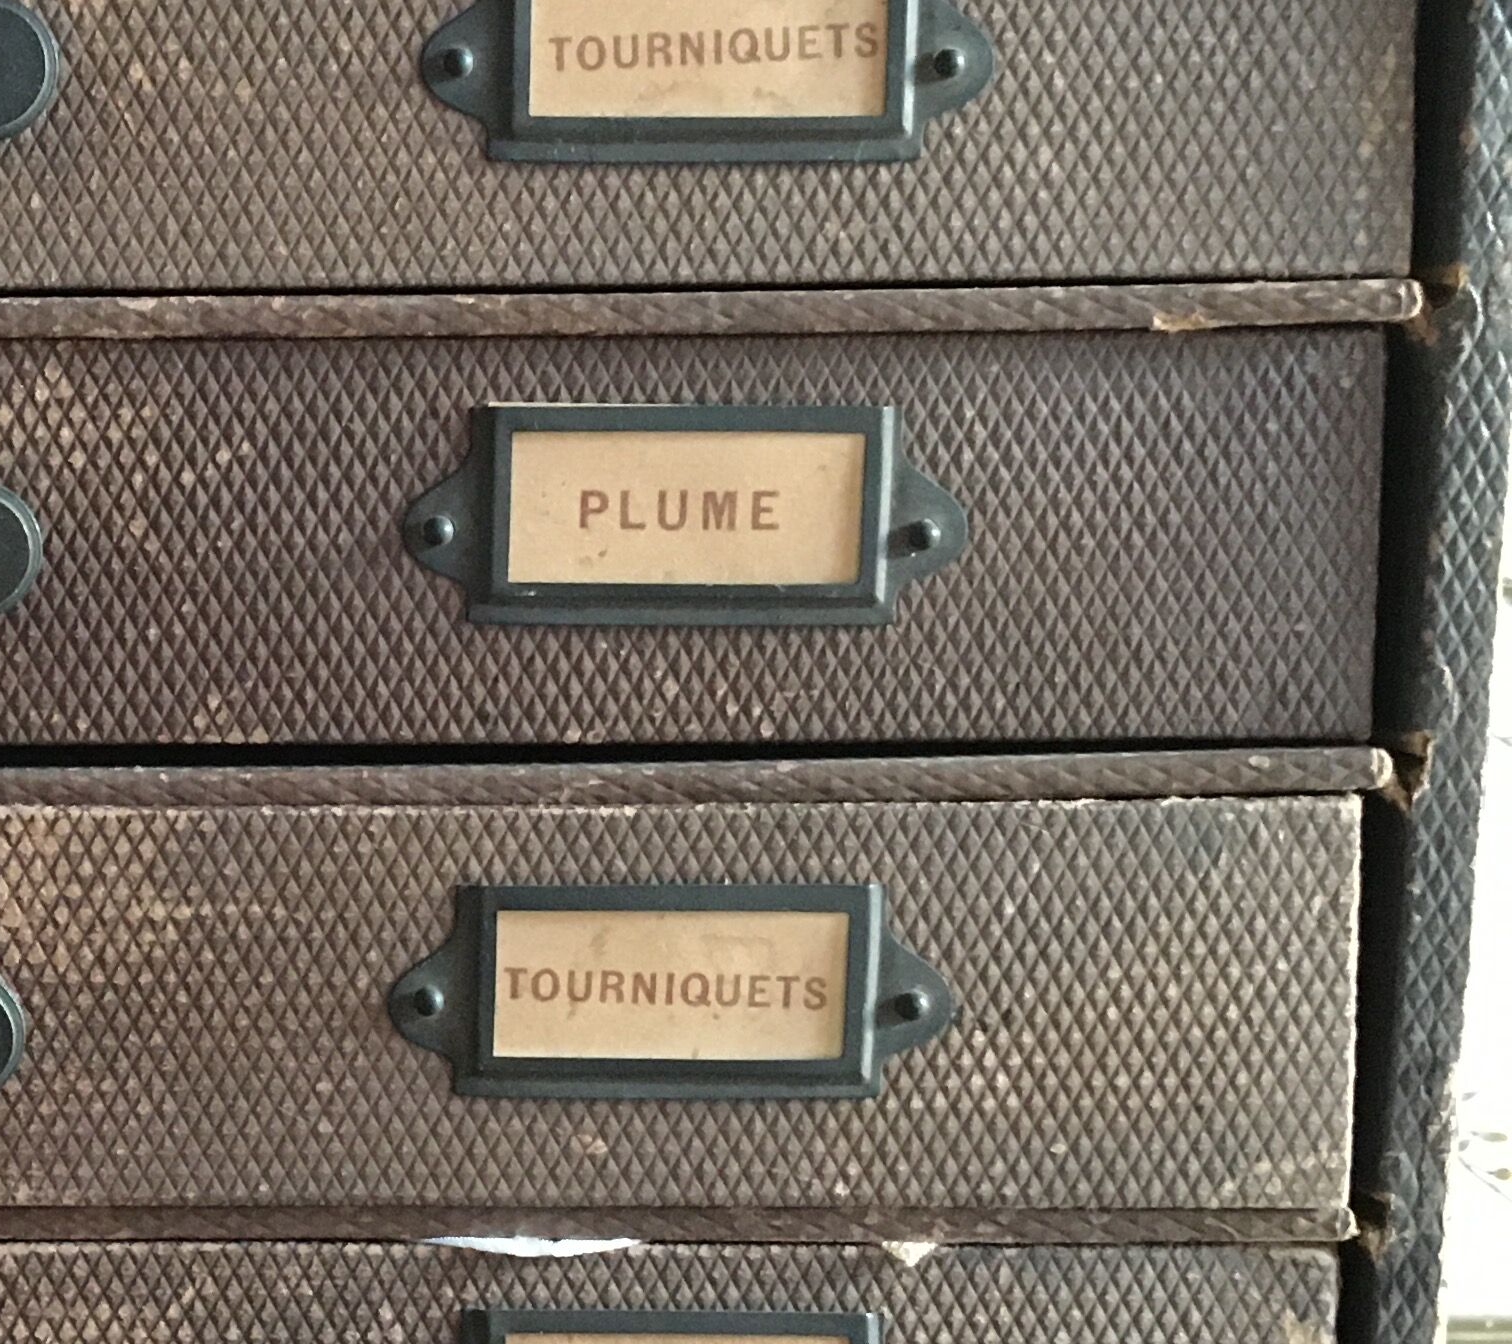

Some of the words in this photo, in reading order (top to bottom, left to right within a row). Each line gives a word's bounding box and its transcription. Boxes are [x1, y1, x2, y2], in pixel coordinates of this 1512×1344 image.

[548, 20, 880, 74] TOURNIQUETS
[578, 487, 781, 532] PLUME
[503, 965, 829, 1012] TOURNIQUETS
